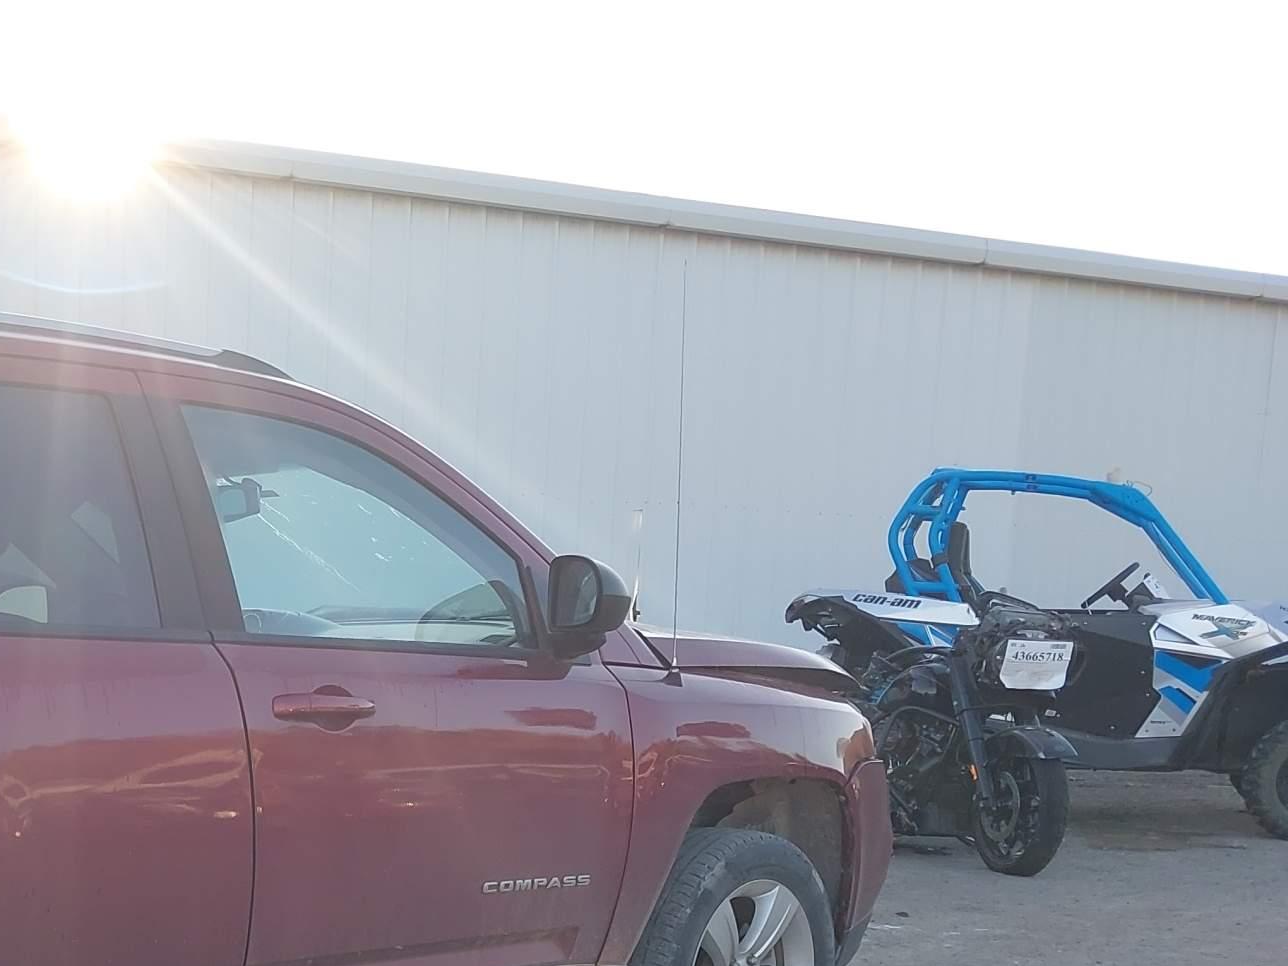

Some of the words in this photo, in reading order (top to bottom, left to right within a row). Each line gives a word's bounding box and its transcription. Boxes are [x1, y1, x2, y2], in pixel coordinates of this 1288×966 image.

[852, 593, 922, 609] can-am
[1192, 614, 1257, 626] MAVERICK
[1012, 651, 1064, 662] 43665718
[482, 874, 591, 894] COMPASS
